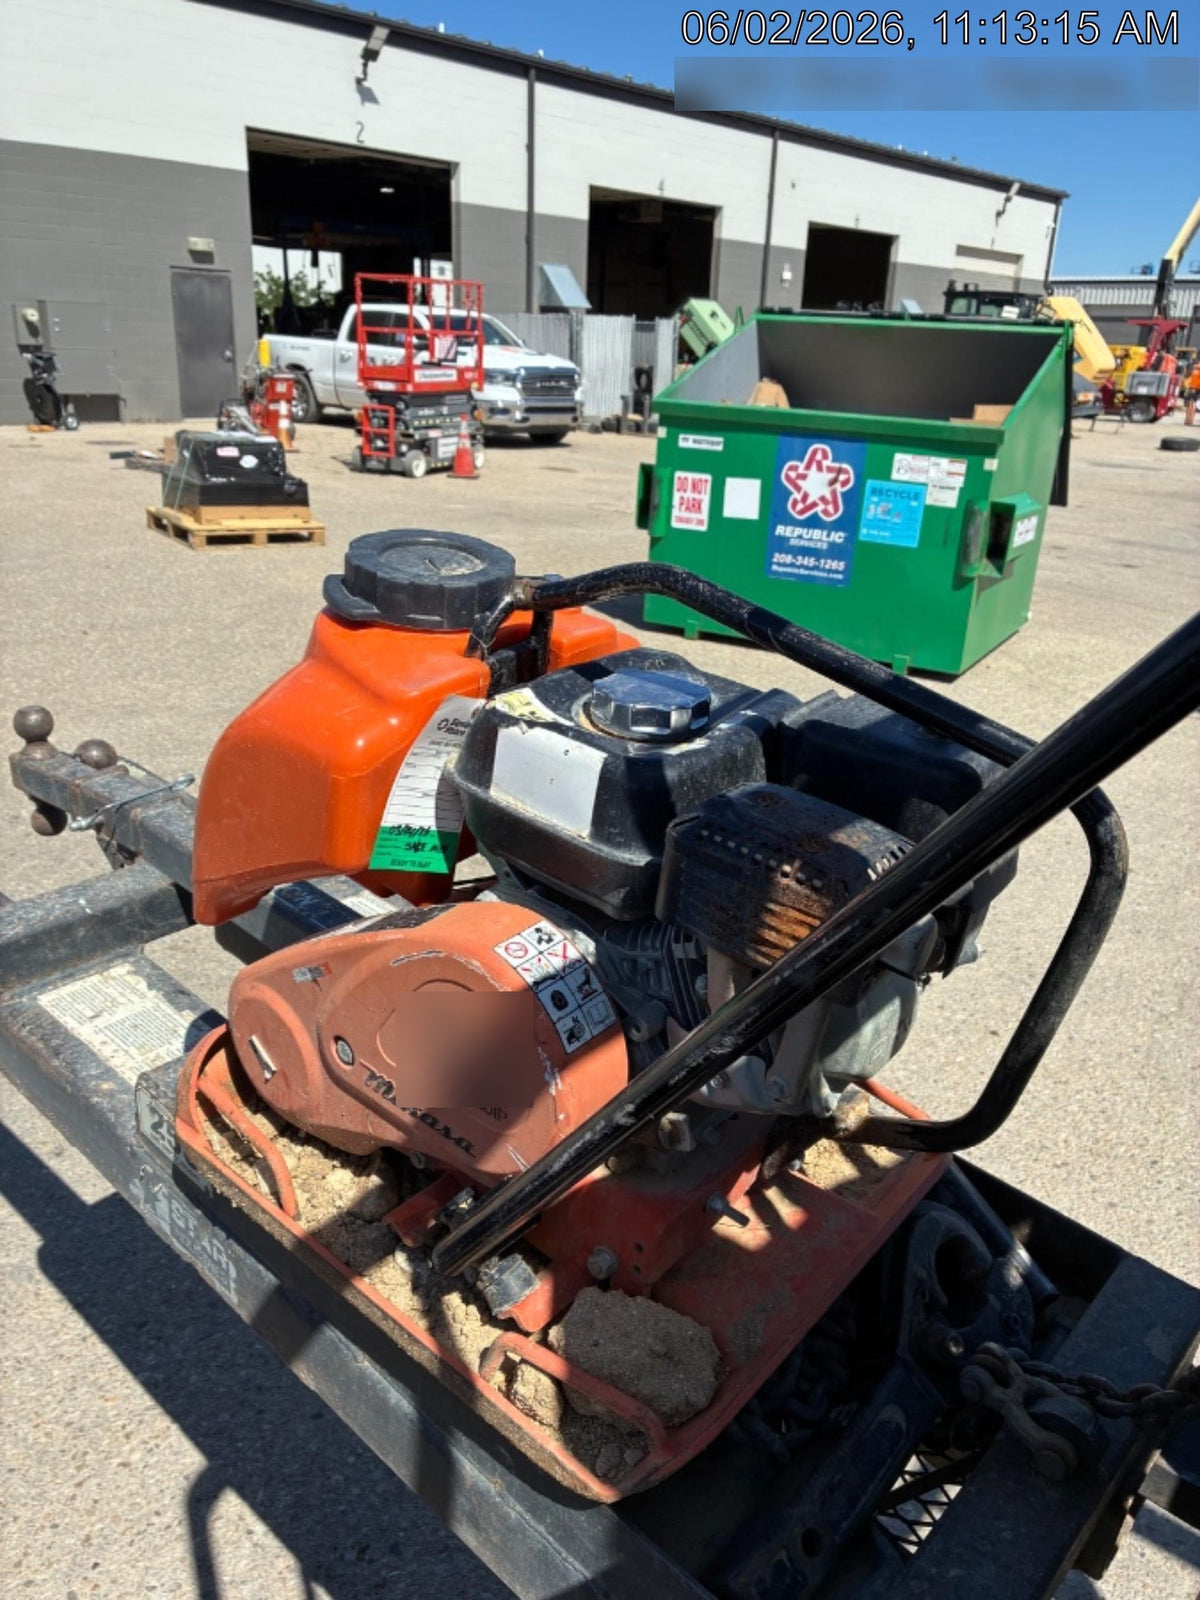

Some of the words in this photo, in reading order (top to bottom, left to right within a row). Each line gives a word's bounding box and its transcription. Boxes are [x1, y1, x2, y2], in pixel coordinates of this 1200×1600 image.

[356, 120, 365, 144] 2
[676, 475, 688, 493] DO
[691, 477, 709, 496] NOT
[870, 486, 921, 501] RECYCLE
[678, 495, 703, 514] PARK
[775, 524, 845, 543] REPUBLIC
[788, 537, 829, 550] SERVICES
[772, 552, 846, 572] 208-345-1265
